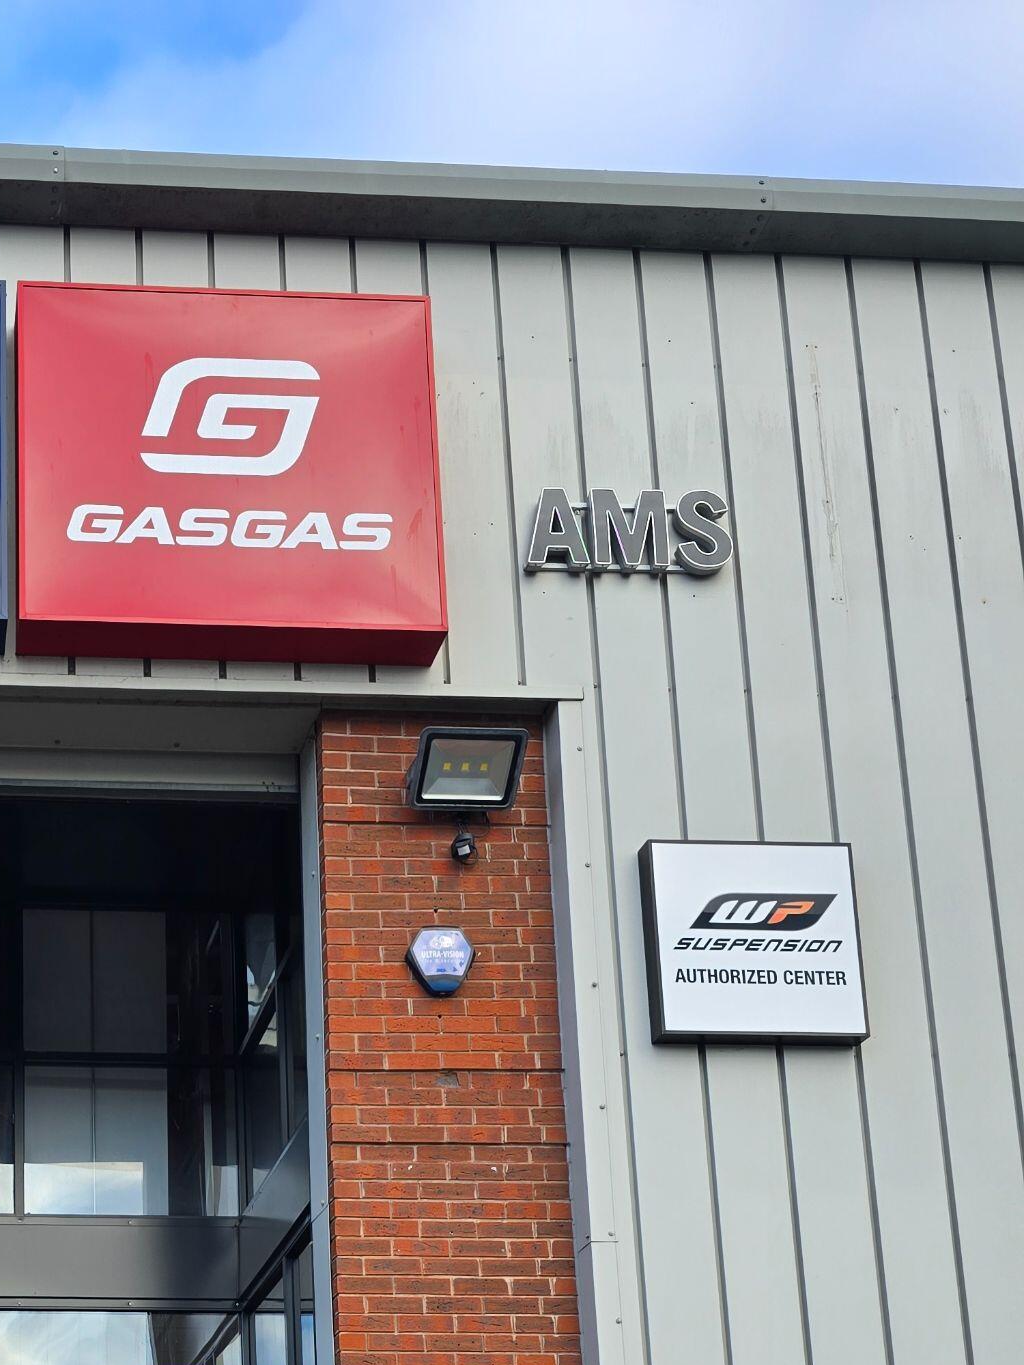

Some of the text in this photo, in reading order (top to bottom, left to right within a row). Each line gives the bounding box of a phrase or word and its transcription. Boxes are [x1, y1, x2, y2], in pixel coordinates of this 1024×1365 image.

[67, 504, 393, 551] GASGAS
[527, 487, 733, 570] AMS
[673, 937, 843, 953] SUSPENSION
[675, 968, 847, 986] AUTHORIZED CENTER
